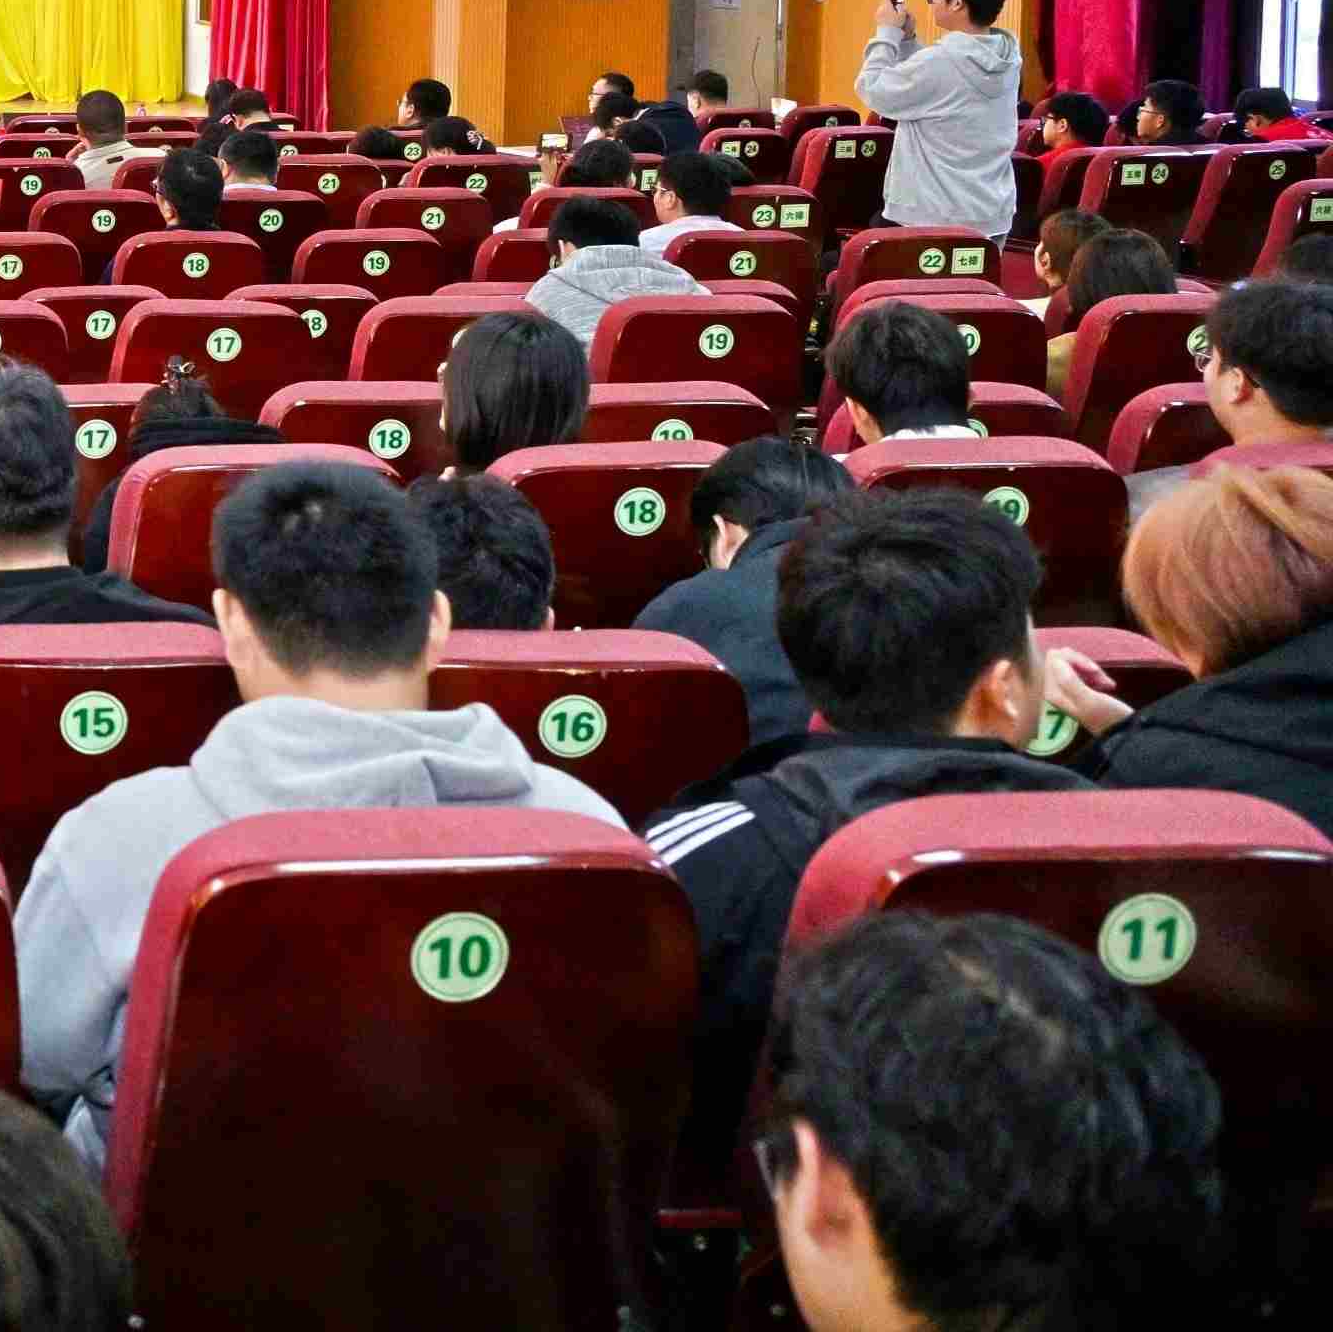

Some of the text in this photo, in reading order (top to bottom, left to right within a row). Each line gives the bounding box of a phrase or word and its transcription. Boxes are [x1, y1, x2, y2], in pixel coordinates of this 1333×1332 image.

[406, 146, 420, 156] 23
[24, 180, 39, 191] 19
[322, 178, 336, 189] 21
[469, 178, 485, 189] 22
[97, 215, 112, 227] 19
[262, 214, 280, 226] 20
[425, 212, 441, 224] 21
[755, 210, 773, 222] 23
[1, 260, 18, 274] 17
[188, 258, 205, 272] 18
[368, 256, 385, 270] 19
[734, 257, 752, 270] 21
[923, 254, 942, 268] 22
[91, 318, 110, 332] 17
[213, 336, 235, 353] 17
[706, 333, 728, 350] 19
[83, 430, 109, 449] 17
[377, 429, 403, 449] 18
[623, 500, 657, 524] 18
[73, 708, 116, 738] 15
[551, 712, 595, 742] 16
[1122, 916, 1177, 961] 11
[429, 934, 492, 980] 10
